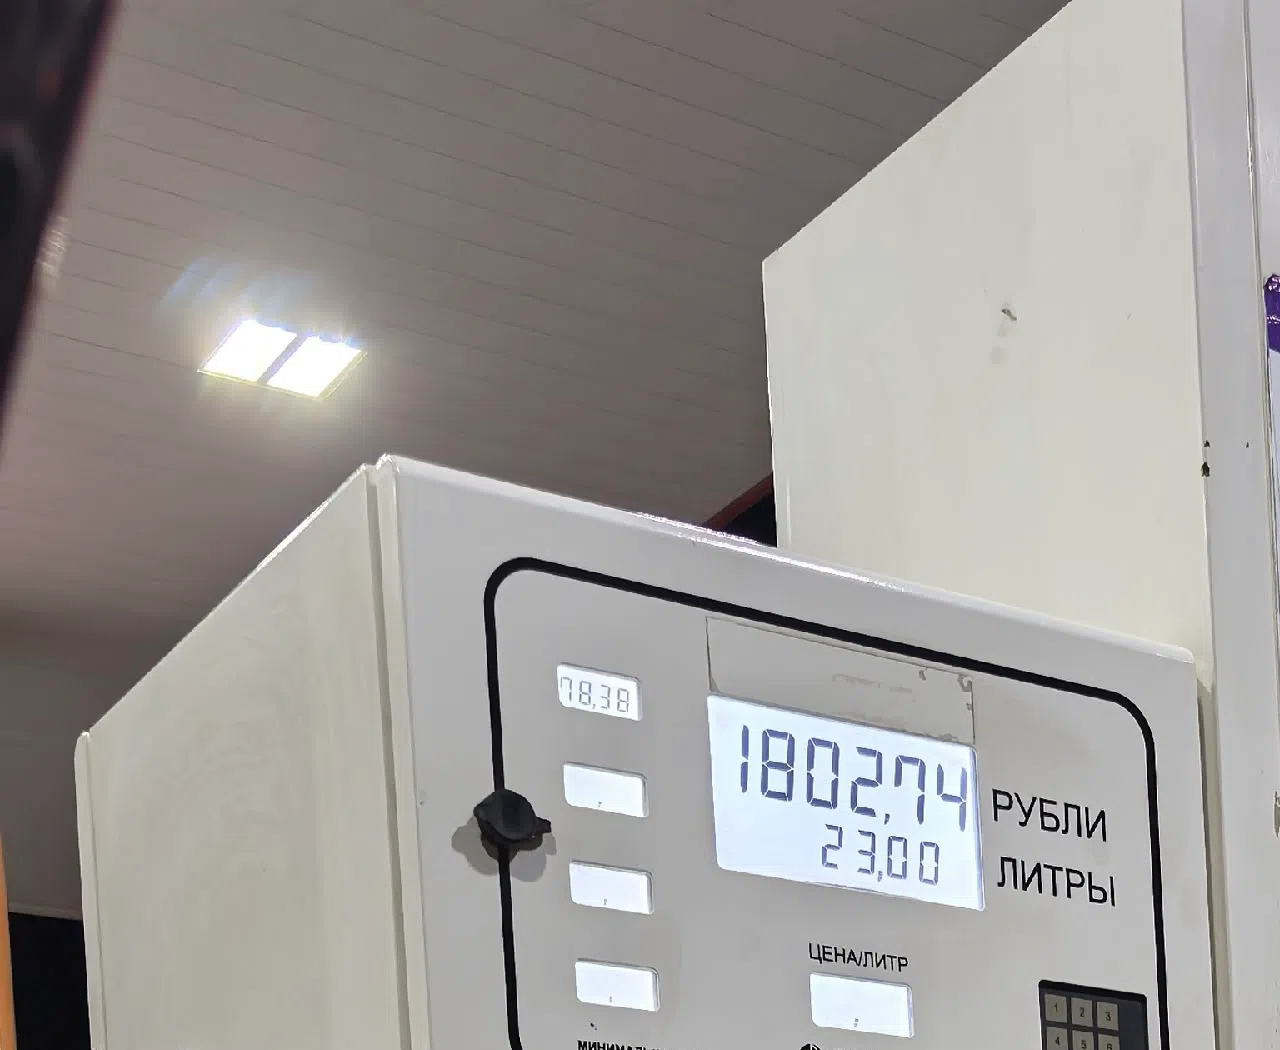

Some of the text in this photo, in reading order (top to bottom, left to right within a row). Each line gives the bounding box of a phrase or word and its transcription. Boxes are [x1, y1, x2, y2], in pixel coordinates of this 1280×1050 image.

[560, 676, 629, 712] 78,38
[740, 724, 968, 832] 1802,74
[992, 788, 1107, 842] РУБЛИ
[821, 823, 940, 885] 23,00
[997, 856, 1116, 907] ЛИТРЫ
[808, 942, 908, 972] ЦЕНА/ЛИТР
[1079, 1007, 1085, 1017] 2
[1105, 1011, 1111, 1021] 3
[1081, 1040, 1087, 1050] 5
